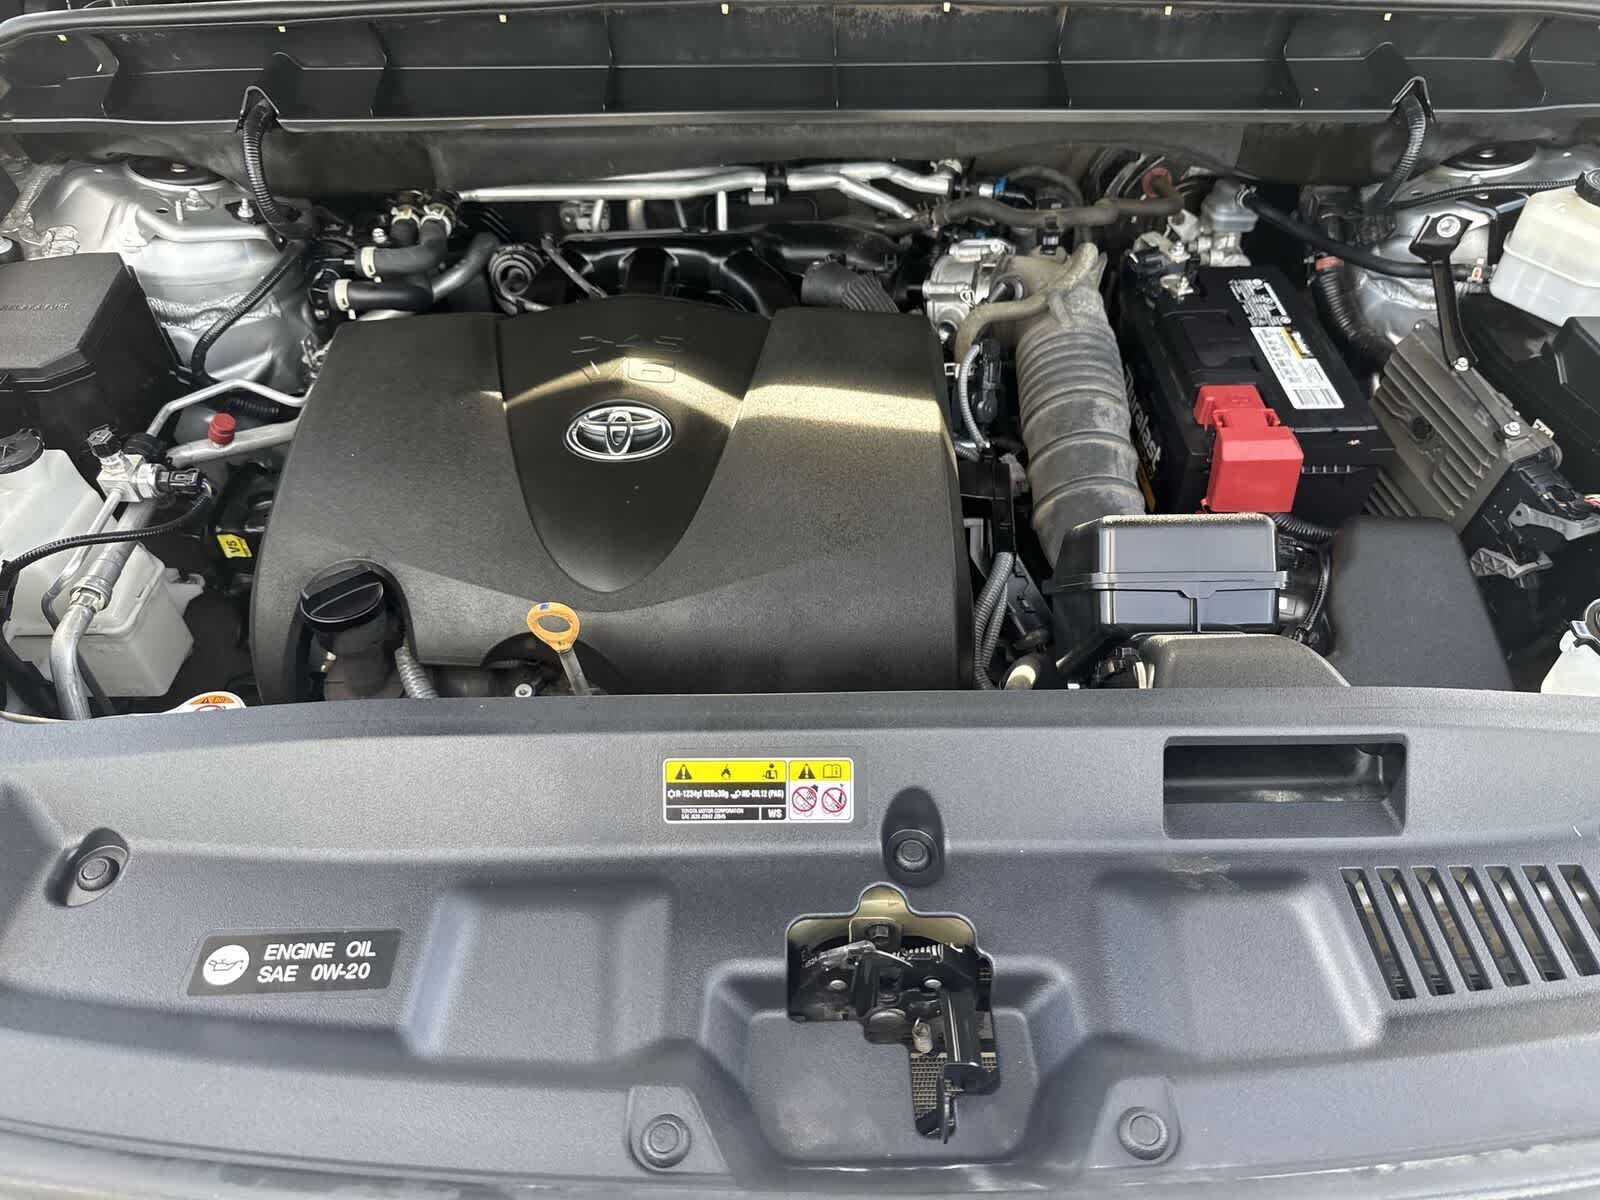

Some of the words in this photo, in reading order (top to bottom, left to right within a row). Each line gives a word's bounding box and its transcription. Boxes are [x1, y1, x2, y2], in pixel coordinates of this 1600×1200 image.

[768, 809, 783, 819] WS
[263, 942, 335, 960] ENGINE
[345, 940, 376, 958] OIL
[256, 965, 299, 983] SAE
[310, 962, 371, 981] 0W-20
